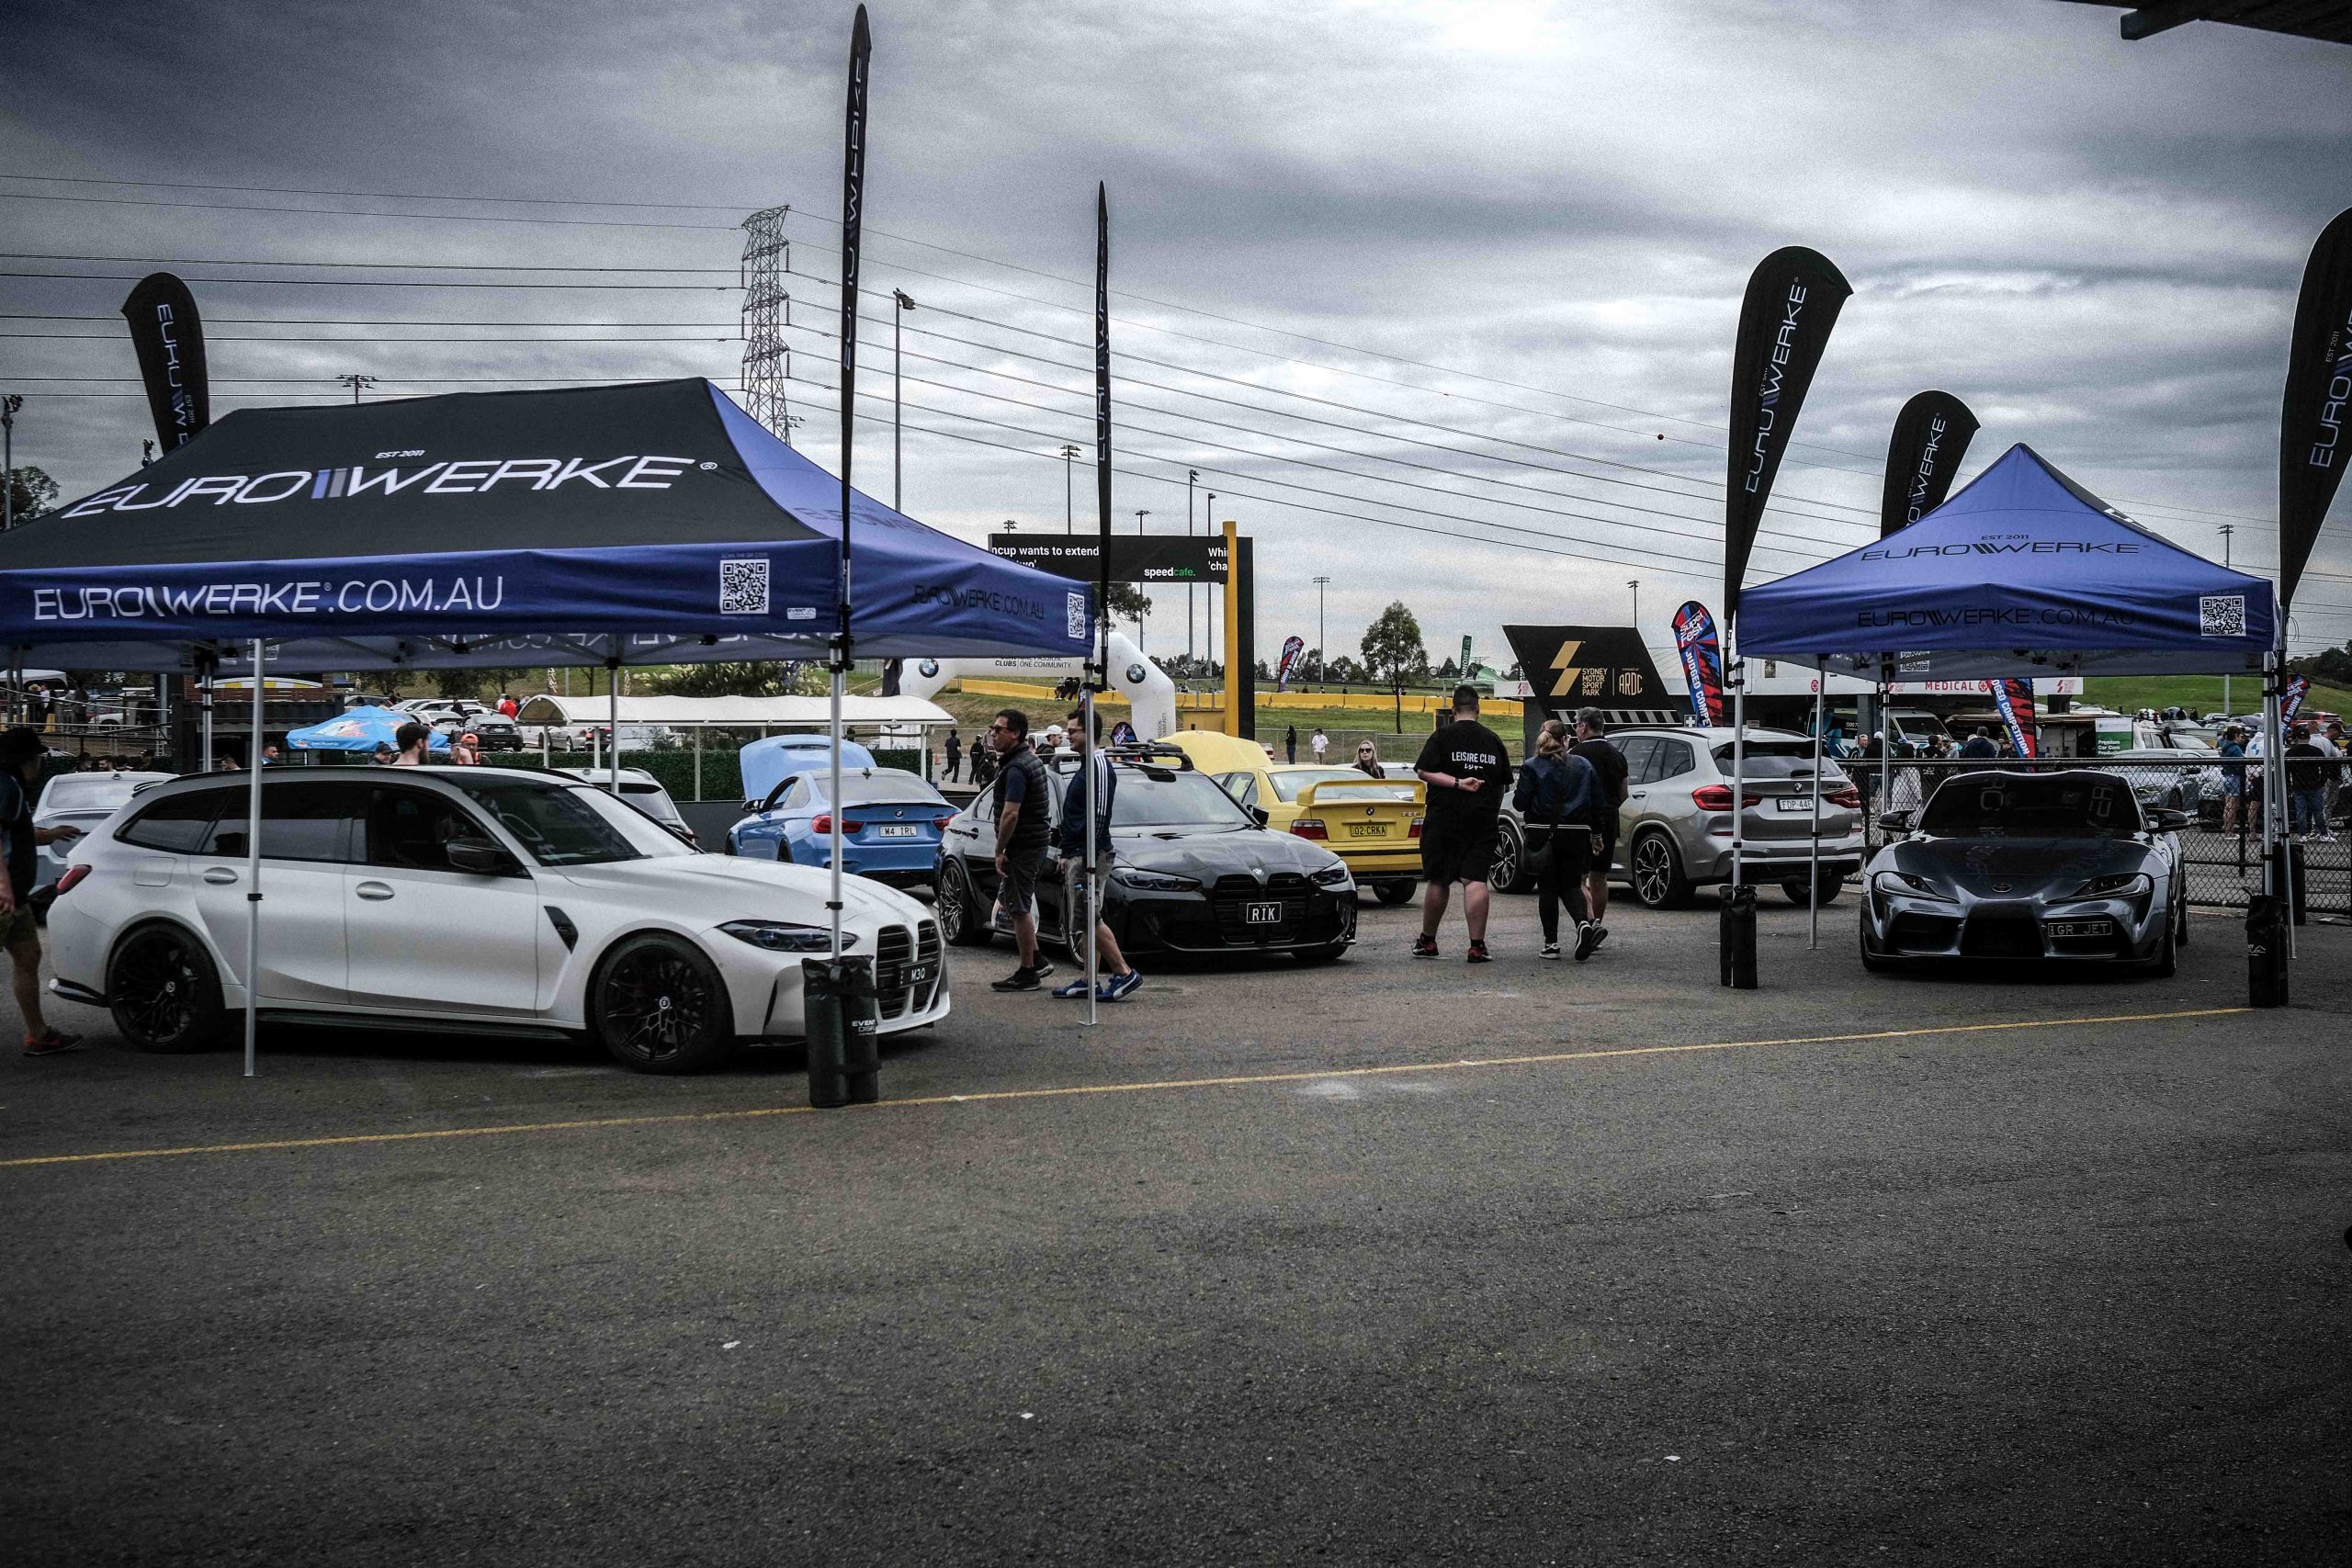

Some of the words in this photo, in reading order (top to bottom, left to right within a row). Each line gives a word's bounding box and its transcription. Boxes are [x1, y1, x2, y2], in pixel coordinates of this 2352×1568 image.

[2329, 330, 2340, 347] 2011
[2325, 350, 2335, 363] EST
[374, 450, 401, 459] EST
[398, 449, 425, 457] 2011
[1019, 546, 1049, 556] wants
[1052, 546, 1062, 556] to
[1065, 546, 1100, 557] extend
[1679, 611, 1704, 636] Super
[1680, 623, 1703, 648] Fest
[1685, 651, 1702, 690] JUDGED
[1619, 672, 1643, 695] ARDC
[1925, 681, 1974, 691] MEDICAL
[2286, 695, 2302, 716] SHINE
[1992, 679, 2007, 702] DGED
[2001, 702, 2030, 755] COMPETITION
[1479, 753, 1497, 764] CLUB
[900, 827, 915, 836] IRL
[1251, 907, 1275, 921] RIK
[2057, 924, 2075, 935] GR
[2083, 923, 2108, 934] JET
